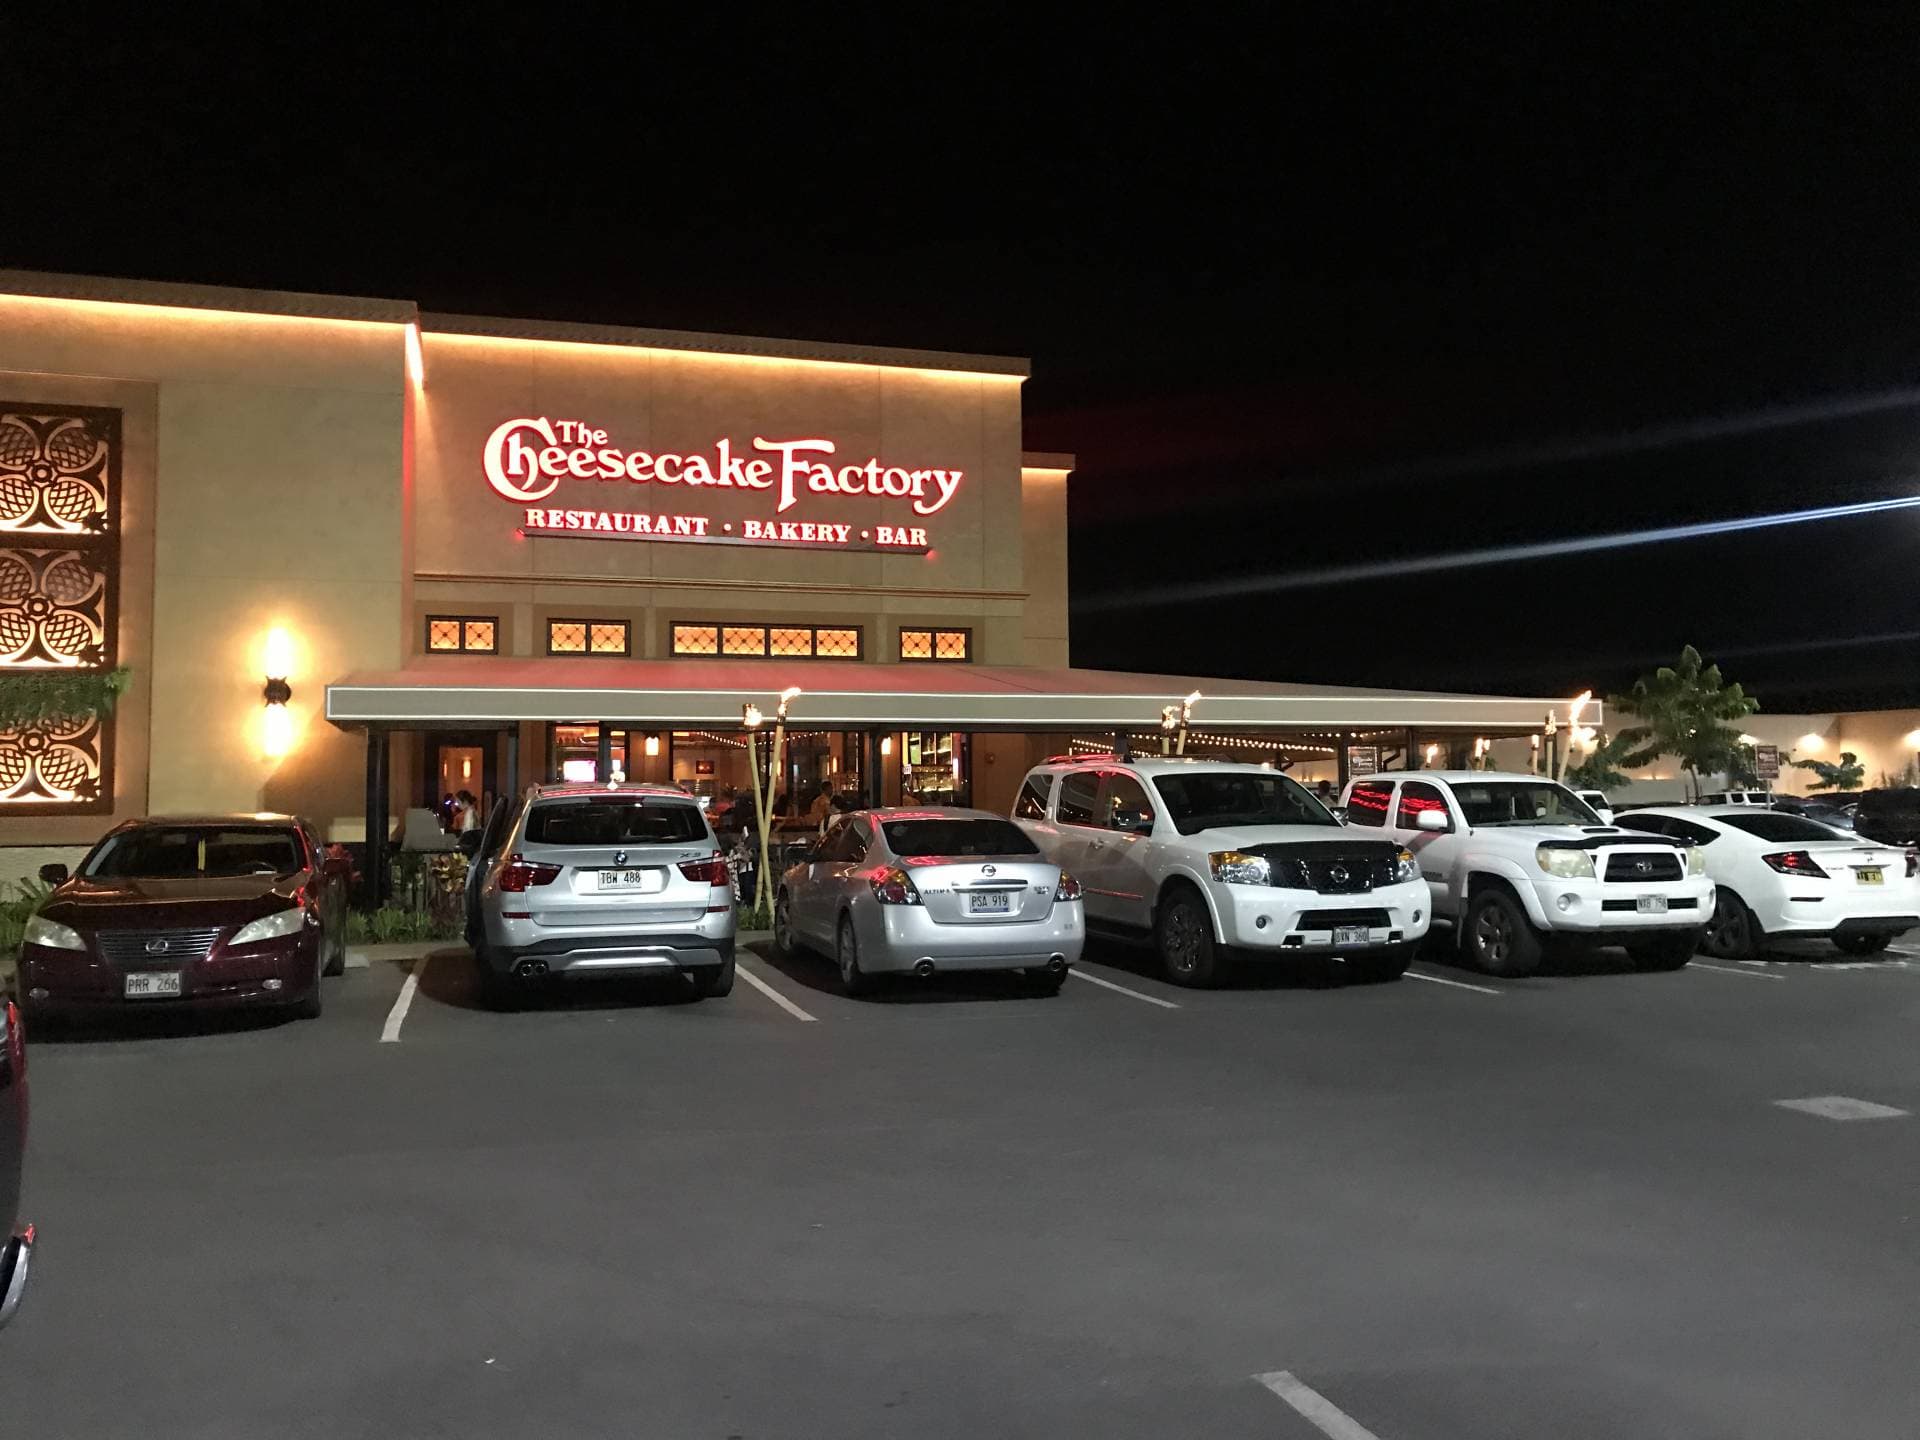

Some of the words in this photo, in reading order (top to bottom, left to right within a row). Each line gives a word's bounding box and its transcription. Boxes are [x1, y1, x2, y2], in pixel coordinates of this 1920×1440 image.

[555, 420, 608, 448] The
[483, 416, 773, 502] Cheesecake
[752, 436, 964, 515] Factory
[525, 508, 709, 537] RESTAURANT
[743, 520, 852, 544] BAKERY
[876, 527, 928, 546] BAR
[971, 895, 988, 907] PSA
[992, 895, 1008, 907] 919
[128, 978, 150, 993] PRR
[157, 977, 179, 992] 266
